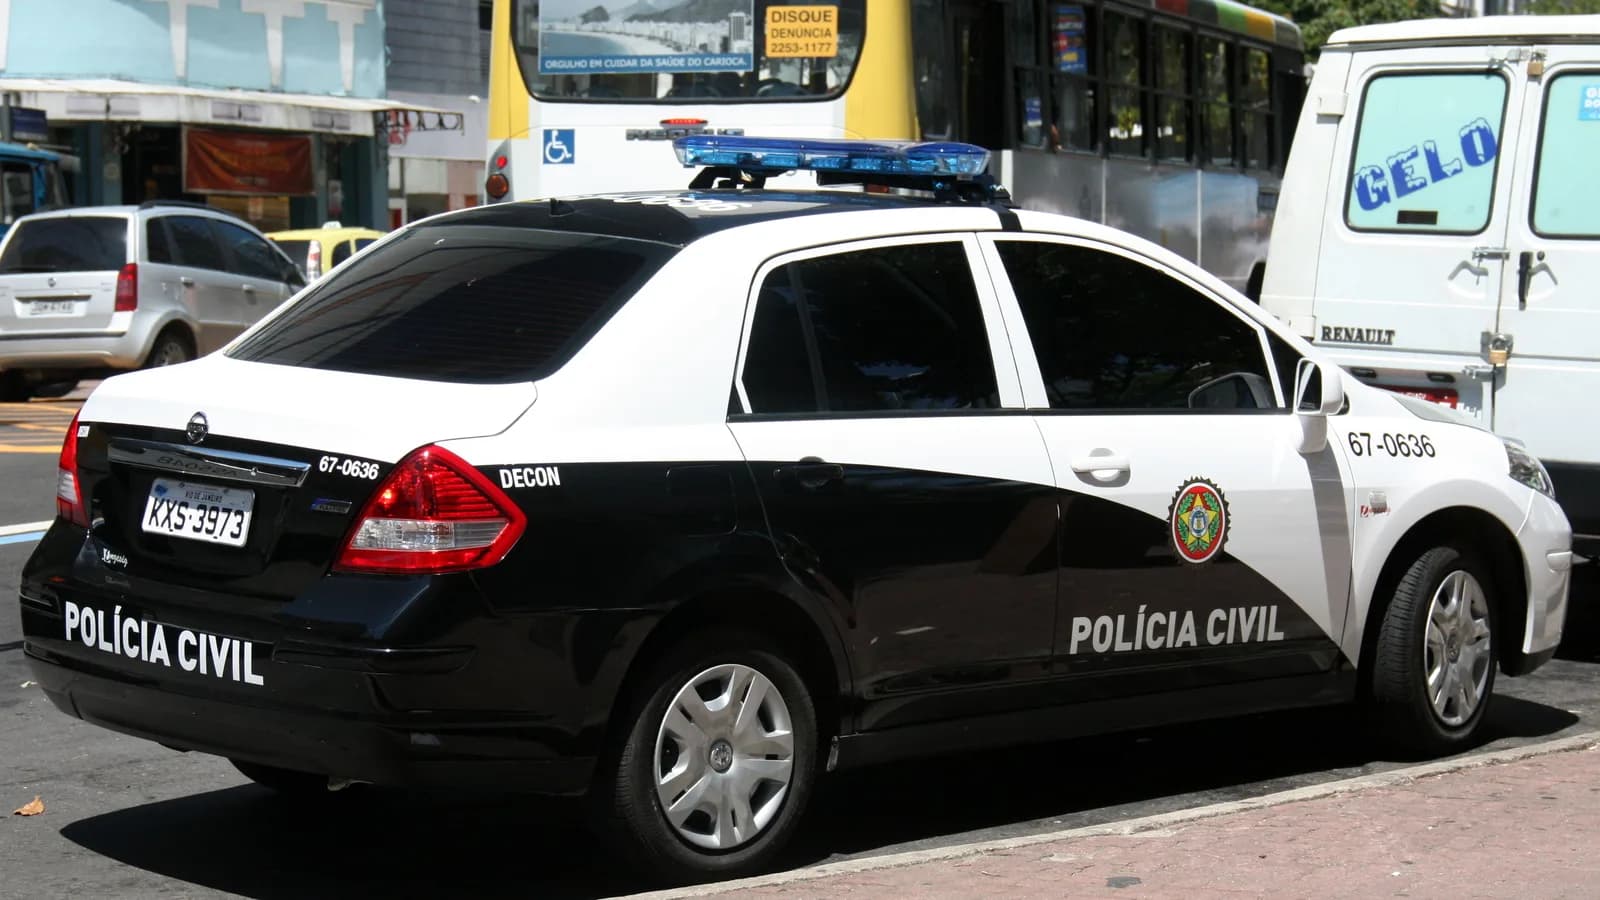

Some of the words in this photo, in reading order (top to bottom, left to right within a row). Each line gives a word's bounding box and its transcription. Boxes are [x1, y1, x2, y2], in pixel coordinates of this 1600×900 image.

[771, 10, 832, 23] DISQUE
[771, 42, 832, 53] 2253-1177
[545, 59, 587, 69] ORGULHO
[589, 59, 602, 68] EM
[604, 58, 637, 68] CUIDAR
[640, 58, 652, 67] DA
[655, 56, 685, 67] SAÚDE
[688, 57, 701, 66] DO
[1354, 117, 1498, 212] GELO
[1321, 326, 1395, 345] RENAULT
[1348, 431, 1436, 458] 67-0636
[319, 456, 380, 480] 67-0636
[499, 466, 561, 489] DECON
[1070, 604, 1198, 655] POLÍCIA
[1206, 604, 1286, 646] CIVIL
[65, 600, 171, 667] POLÍCIA
[178, 629, 265, 686] CIVIL
